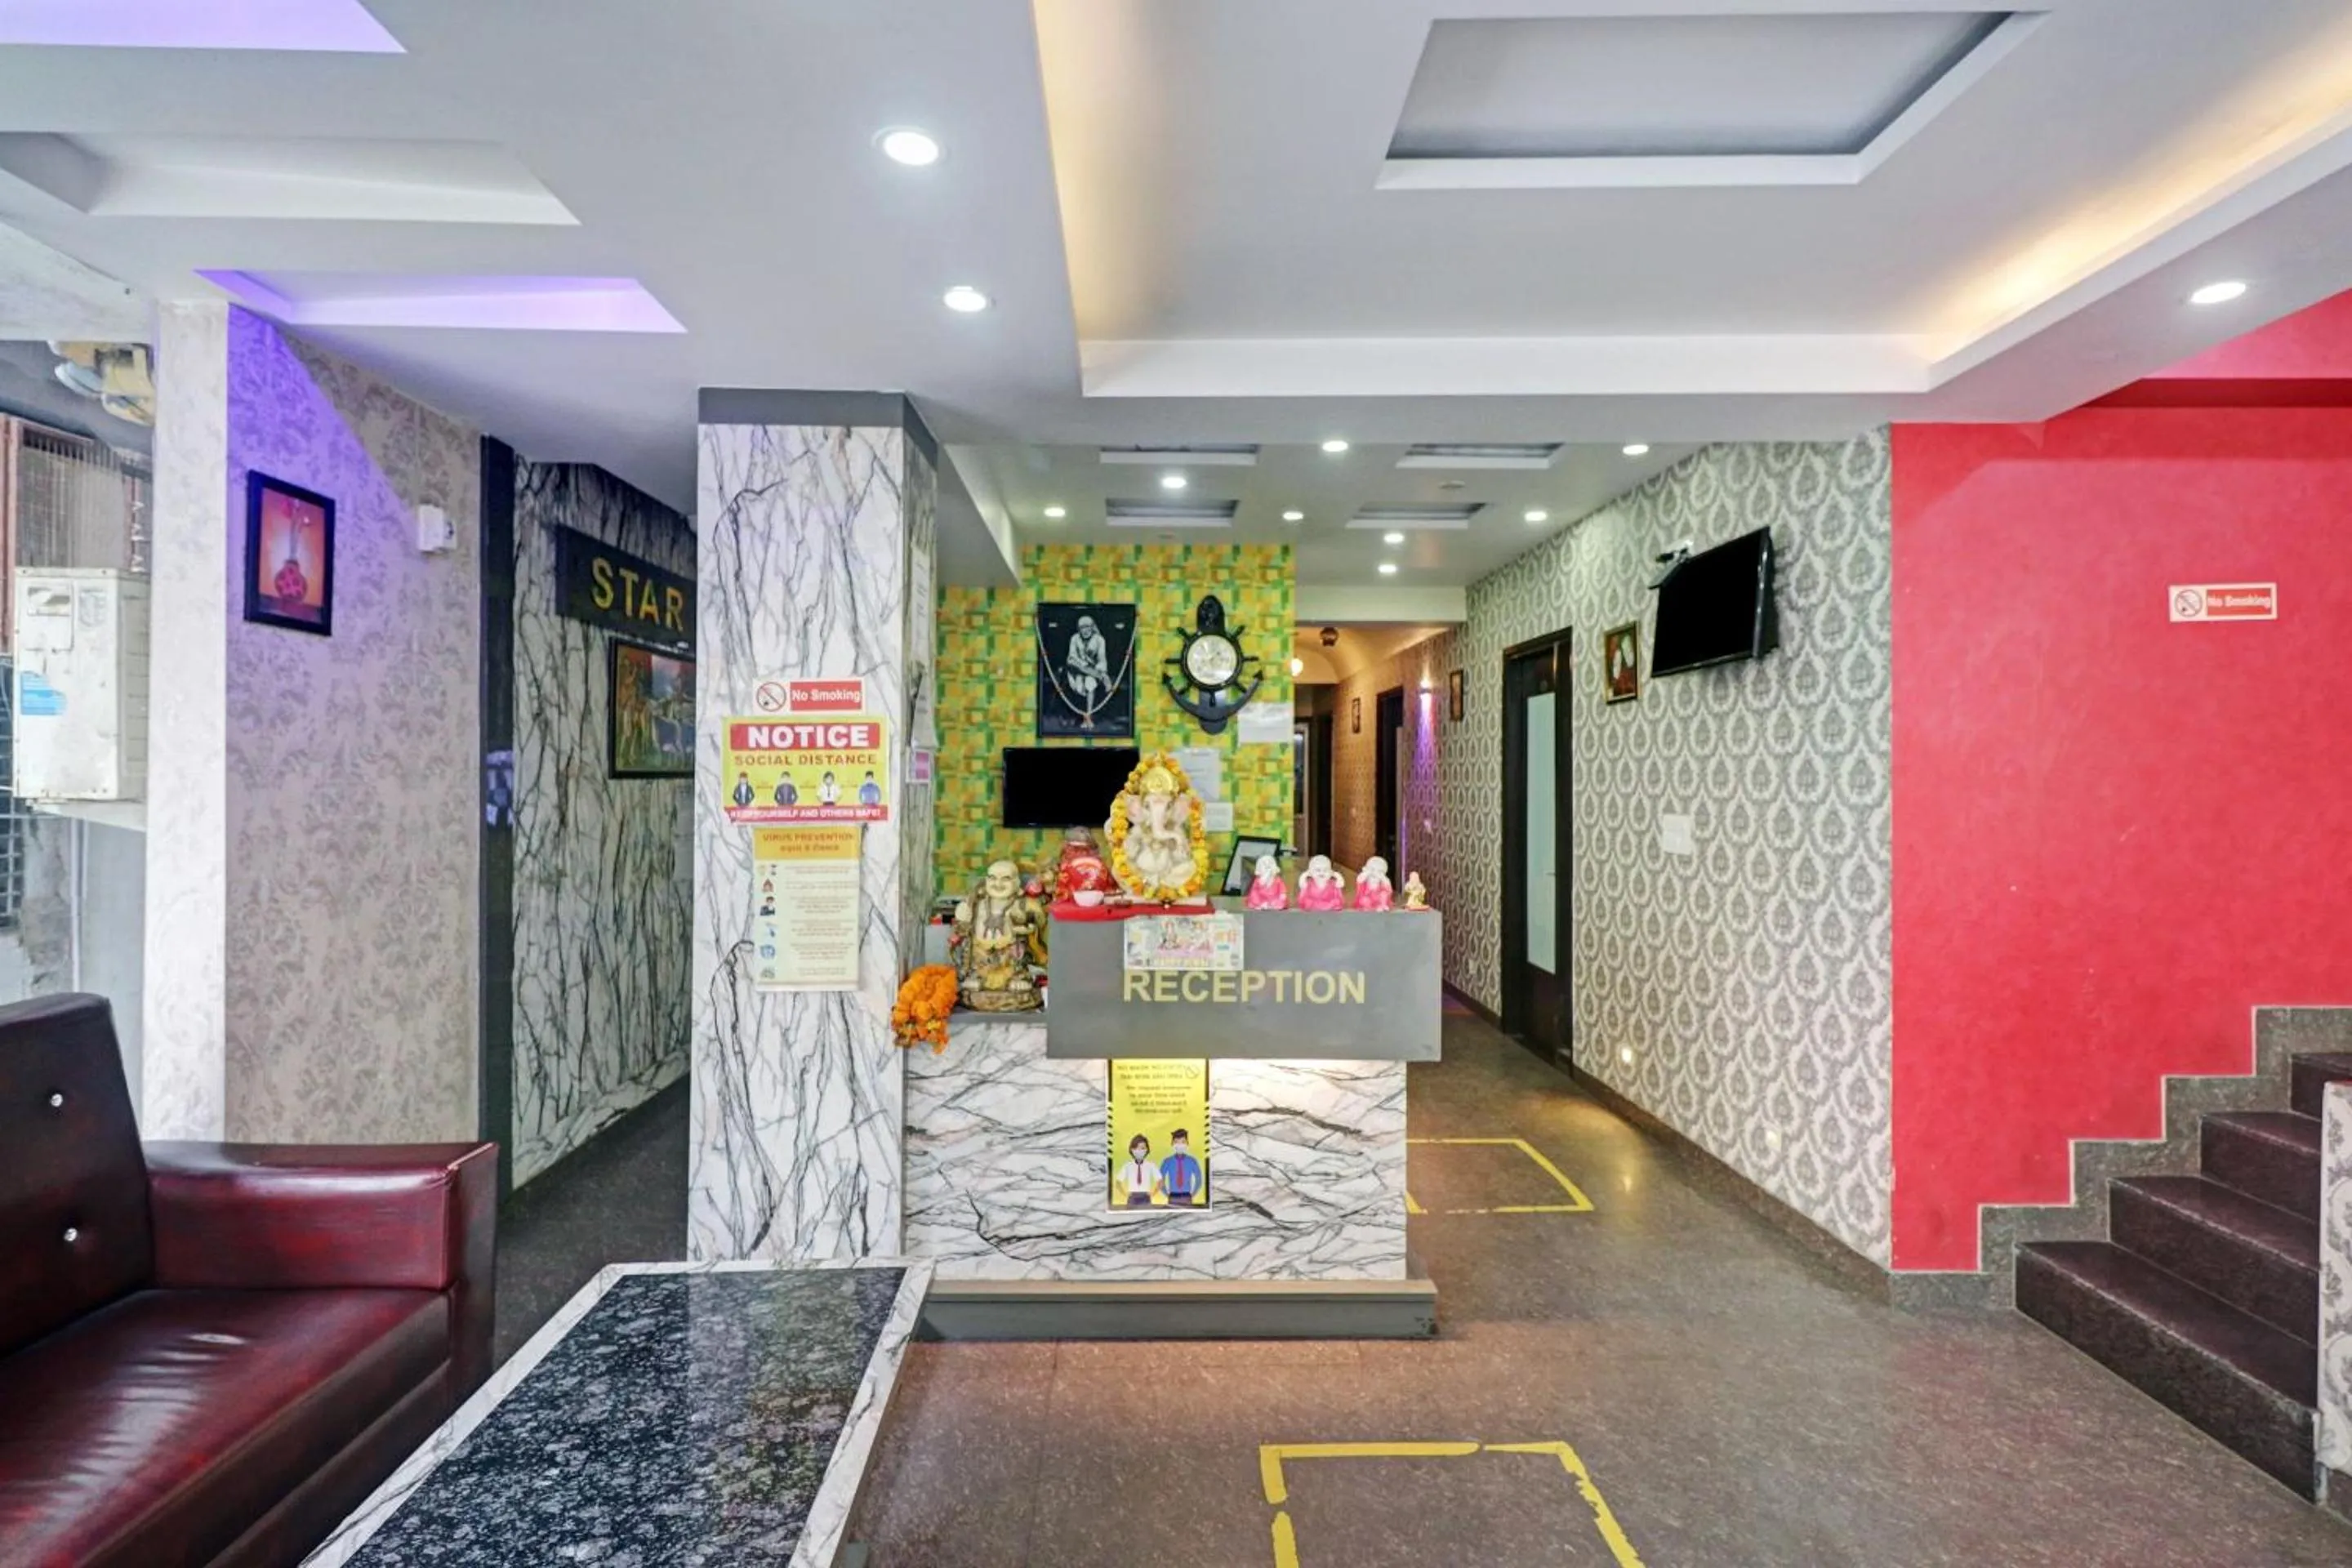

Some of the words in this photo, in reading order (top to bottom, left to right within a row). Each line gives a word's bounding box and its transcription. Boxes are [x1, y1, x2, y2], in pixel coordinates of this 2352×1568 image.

[590, 556, 684, 632] STAR
[791, 689, 808, 701] No
[811, 688, 861, 703] Smoking
[747, 725, 870, 749] NOTICE
[735, 754, 793, 766] SOCIAL
[798, 754, 877, 765] DISTANCE
[1123, 969, 1366, 1004] RECEPTION
